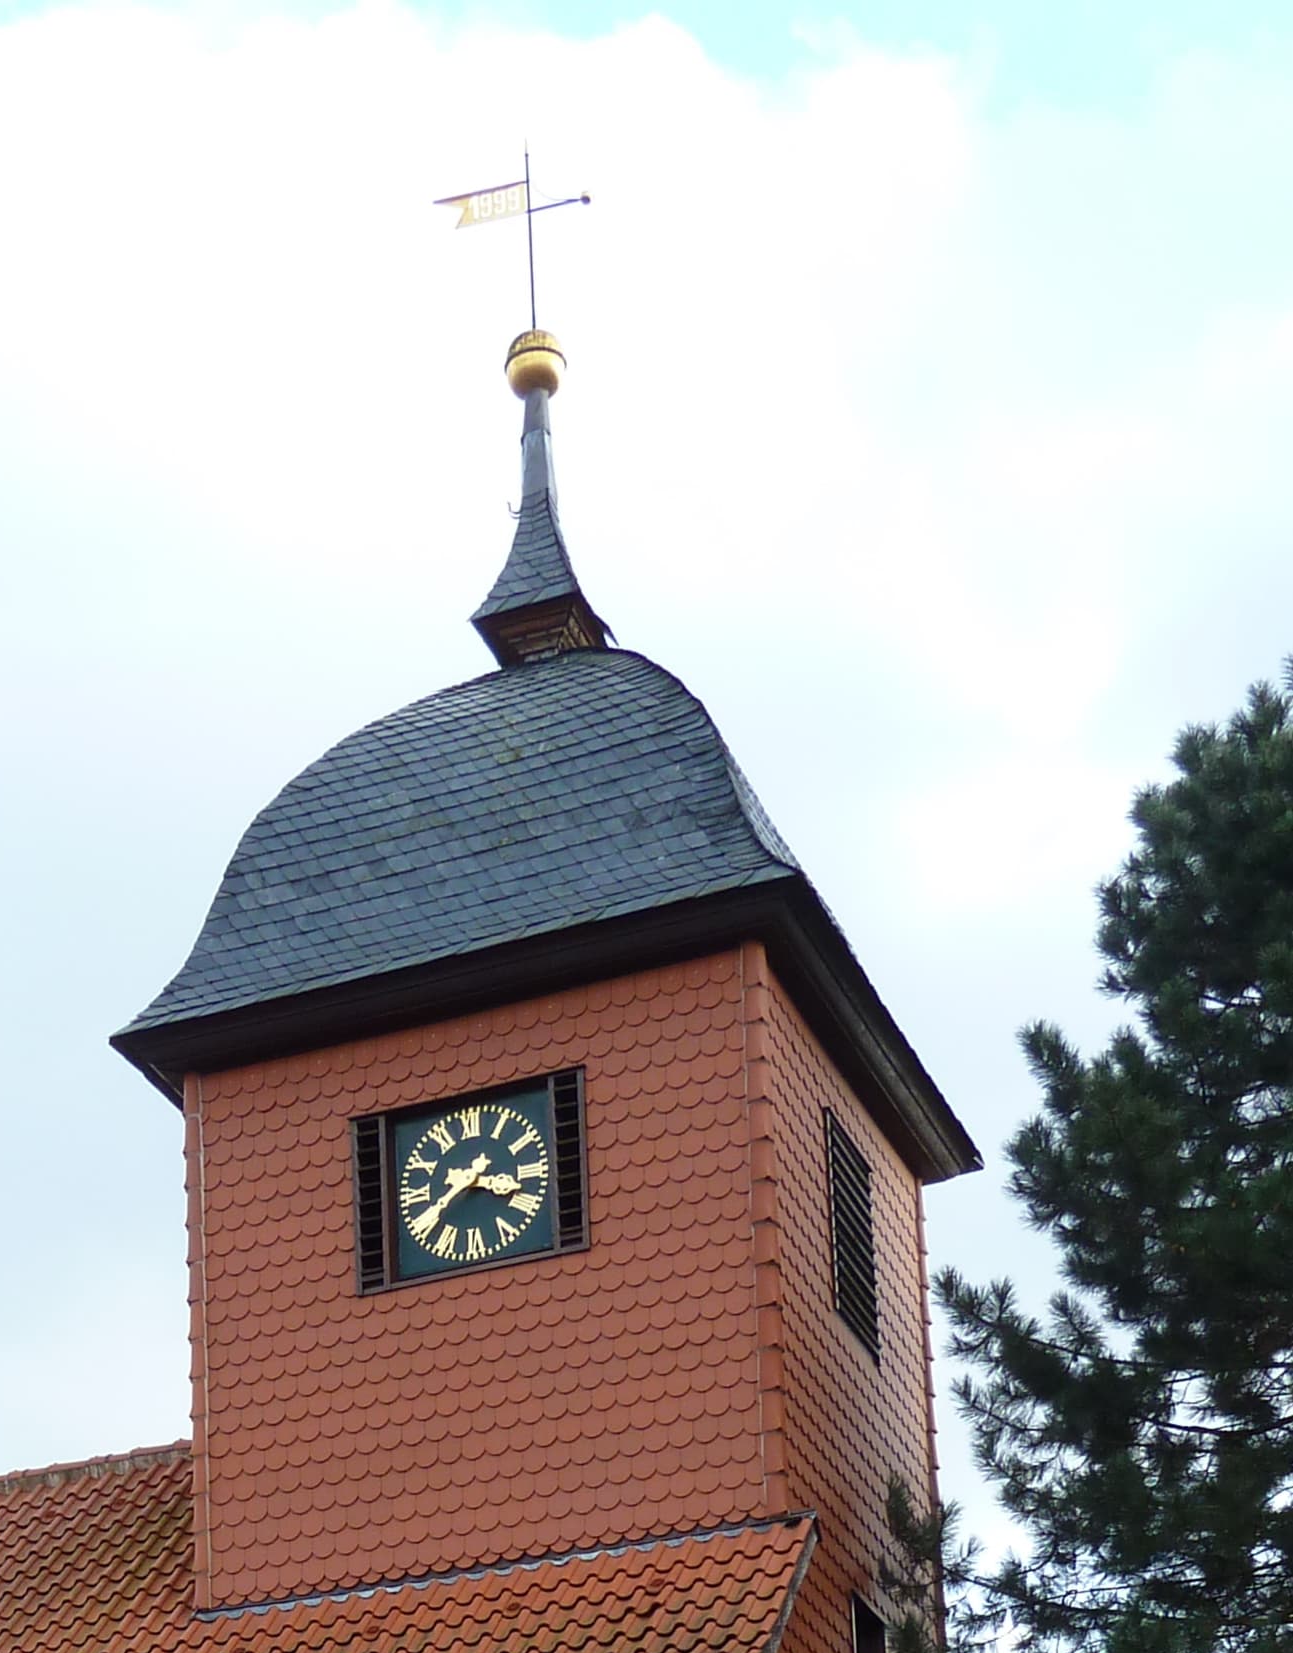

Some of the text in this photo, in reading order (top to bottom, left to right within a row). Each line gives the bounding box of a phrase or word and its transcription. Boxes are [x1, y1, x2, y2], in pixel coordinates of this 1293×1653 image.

[428, 1122, 456, 1155] XI
[460, 1110, 481, 1140] XII
[490, 1111, 510, 1140] I
[508, 1129, 537, 1156] II
[406, 1151, 438, 1176] X
[517, 1160, 546, 1180] III
[401, 1182, 430, 1205] IX
[435, 1224, 458, 1254] VII
[466, 1227, 485, 1257] VI
[495, 1216, 519, 1244] V
